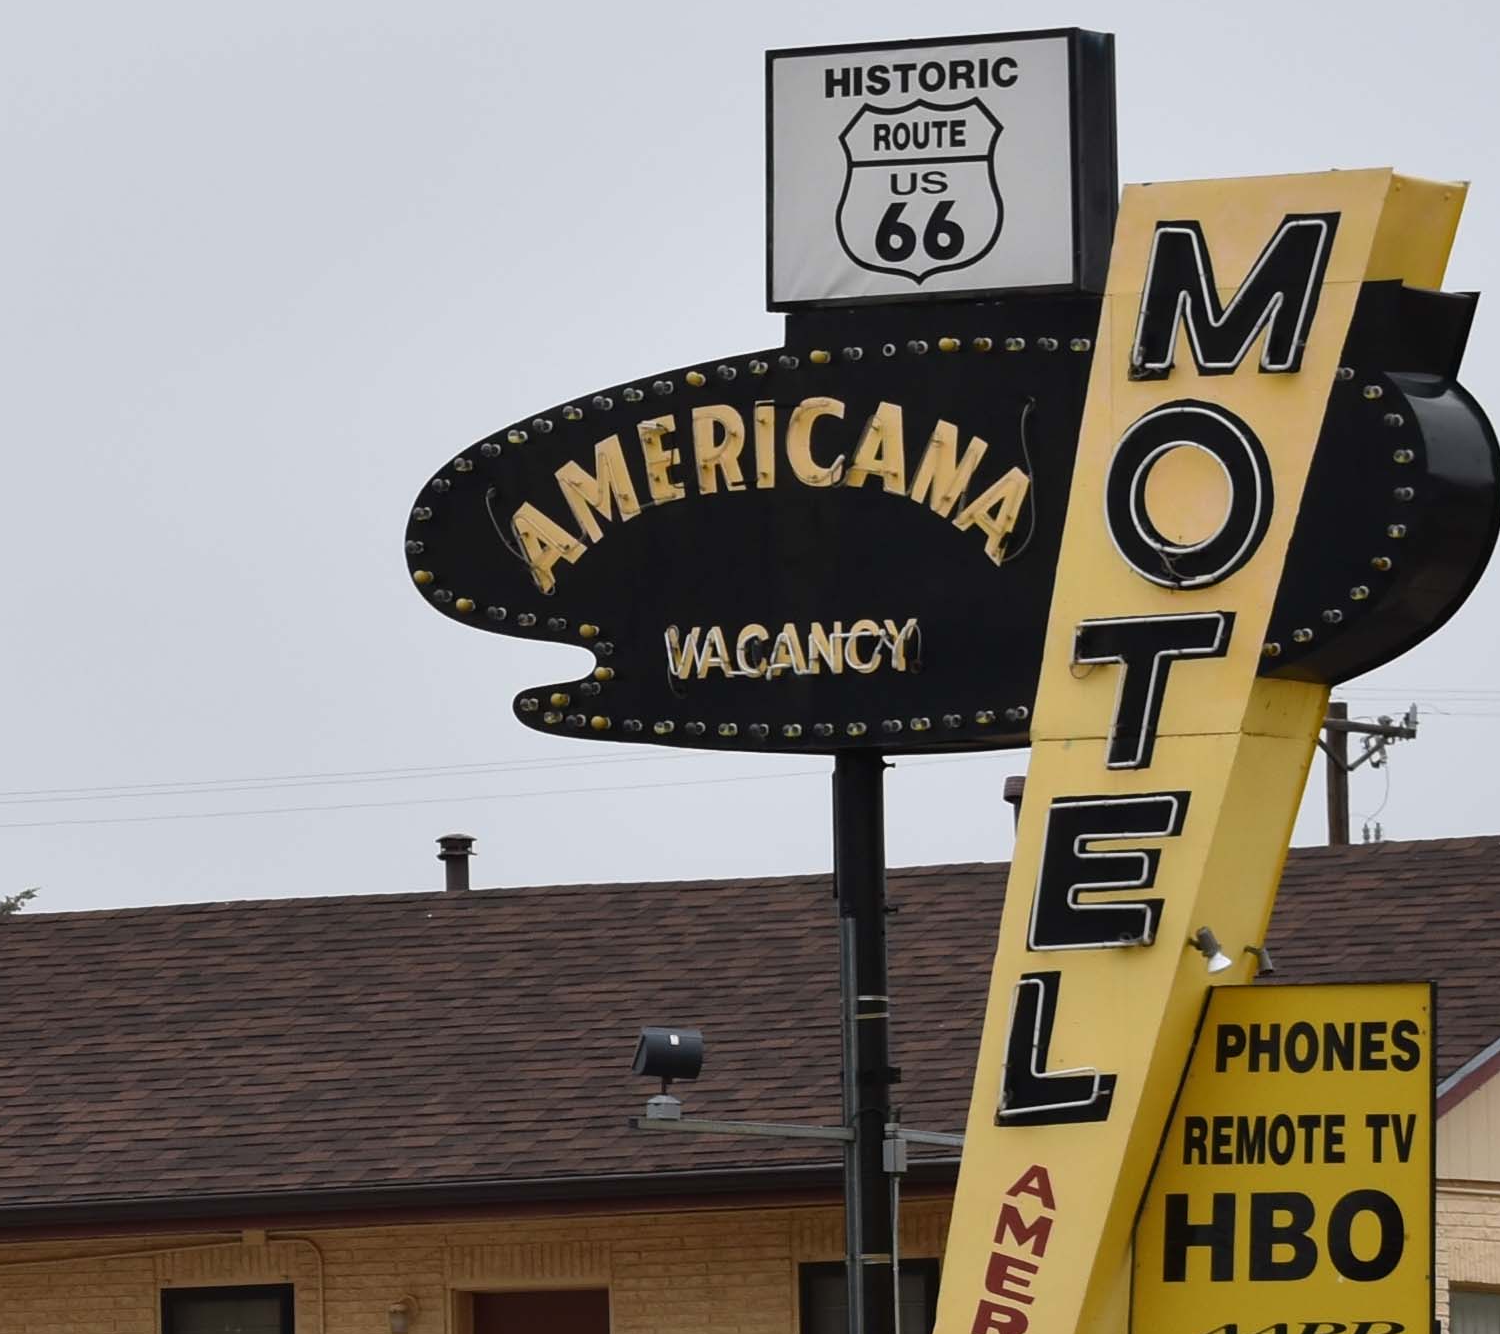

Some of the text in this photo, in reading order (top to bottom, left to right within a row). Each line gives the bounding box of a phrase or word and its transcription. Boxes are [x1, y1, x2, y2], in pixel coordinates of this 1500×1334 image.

[823, 56, 1019, 99] HISTORIC
[872, 119, 967, 152] ROUTE
[889, 170, 949, 196] US
[874, 199, 965, 263] 66
[510, 395, 1032, 595] AMERICANA
[664, 617, 919, 681] VACANCY
[995, 212, 1340, 1127] MOTEL
[1214, 1019, 1421, 1075] PHONES
[1182, 1113, 1417, 1166] REMOTE TV
[1162, 1188, 1406, 1283] HBO
